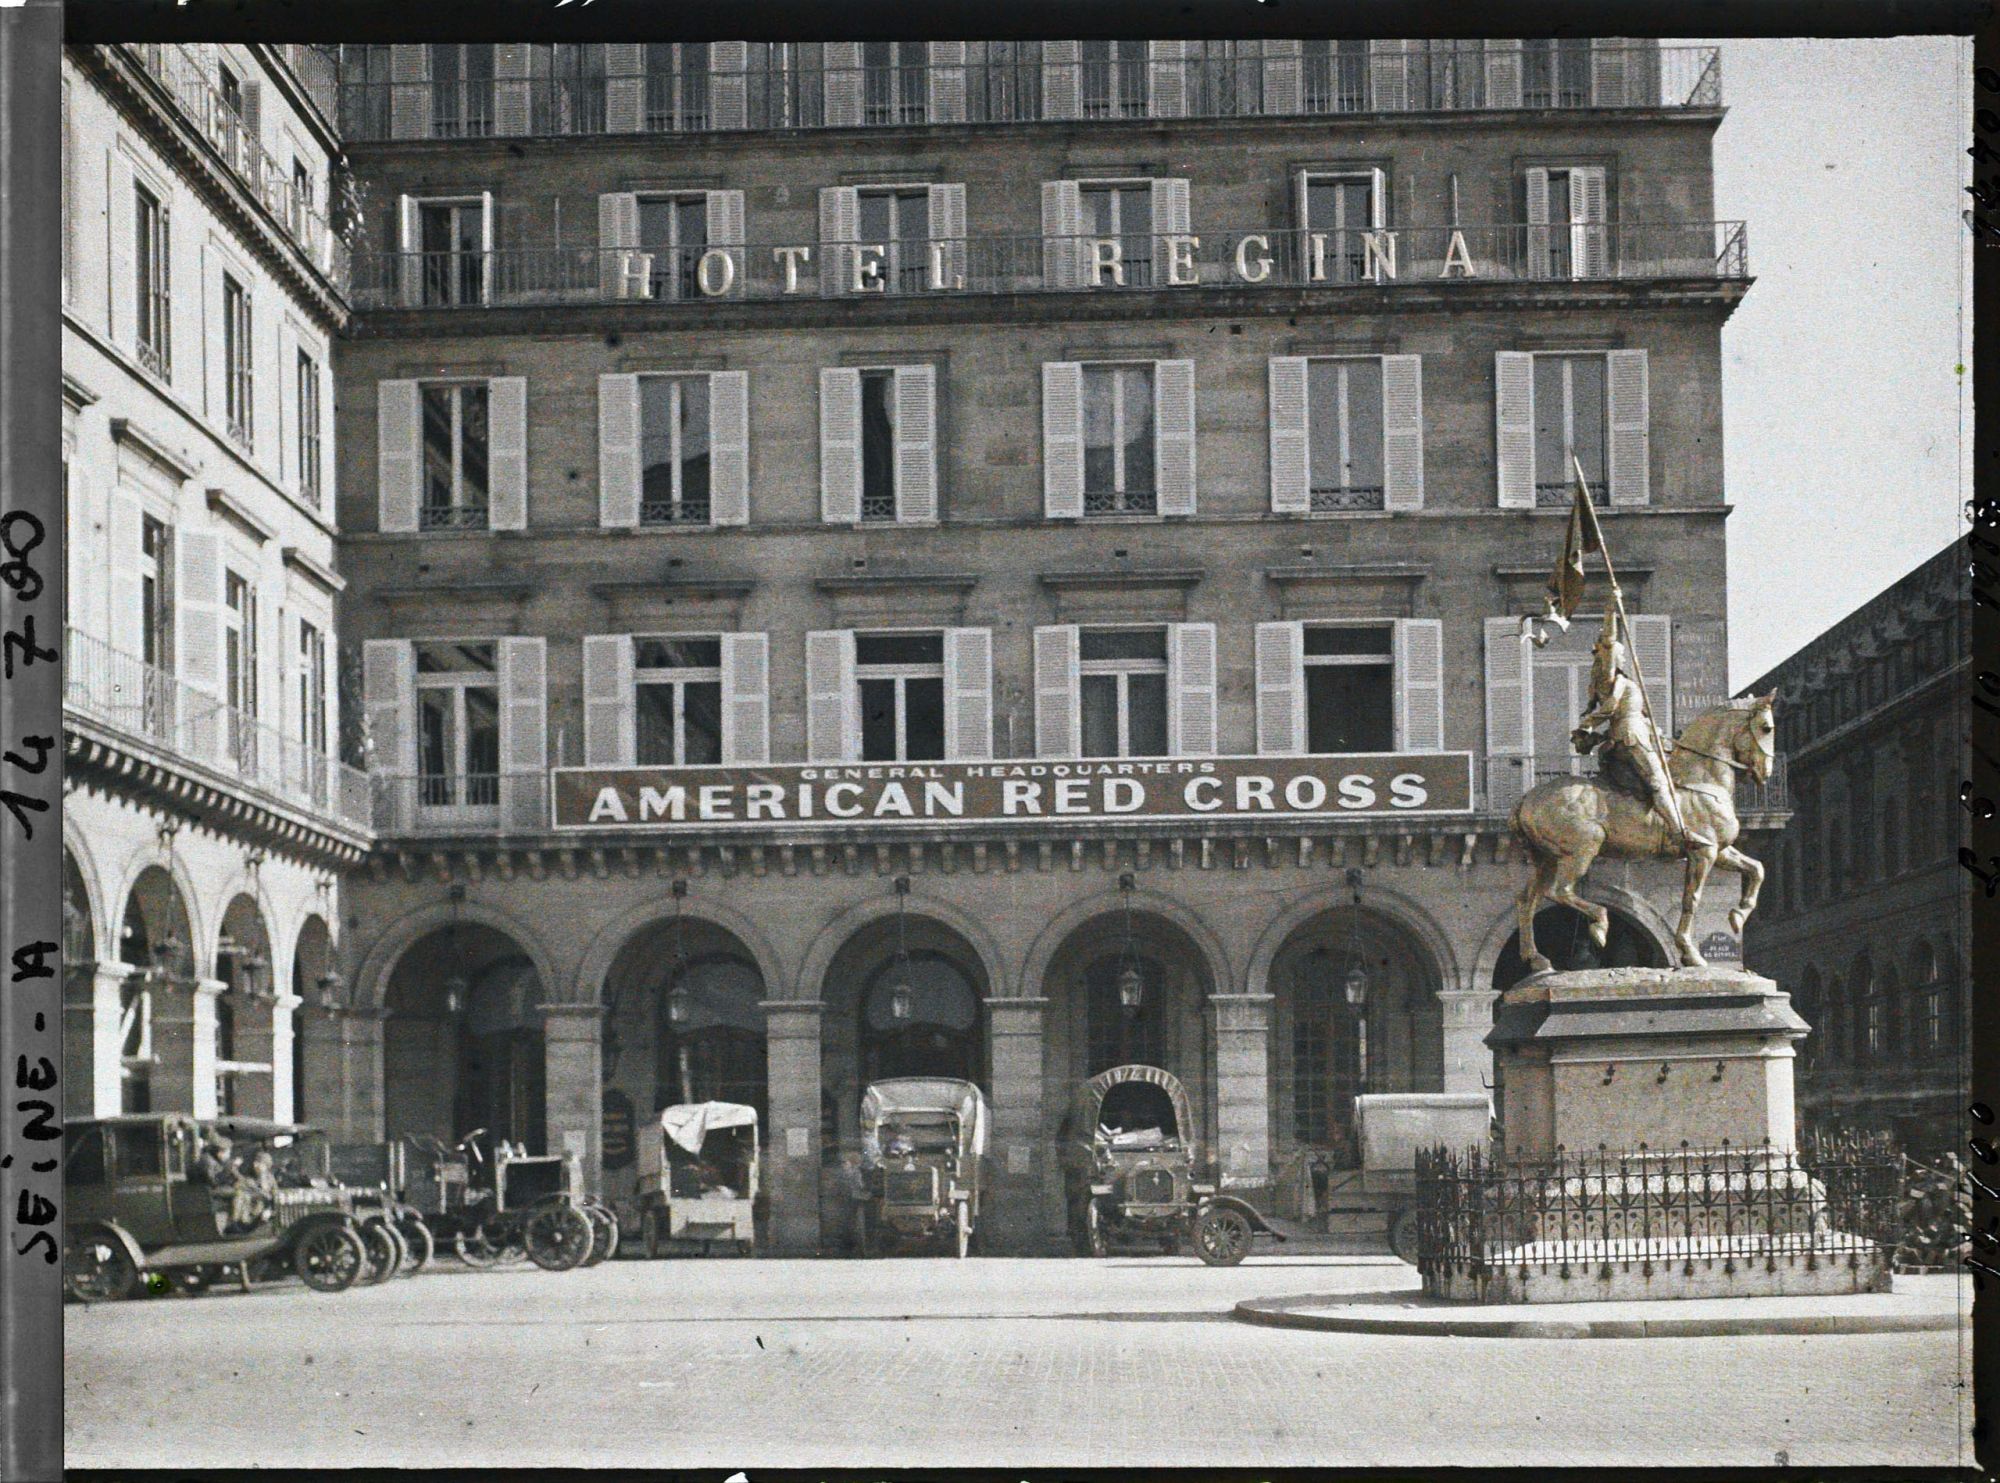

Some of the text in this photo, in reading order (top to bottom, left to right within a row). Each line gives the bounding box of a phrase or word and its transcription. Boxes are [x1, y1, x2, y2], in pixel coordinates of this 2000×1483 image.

[617, 230, 1477, 299] HOTEL REGINA
[800, 762, 1216, 780] GENERAL HEADQUARTERS
[588, 774, 1428, 822] AMERICAN RED CROSS
